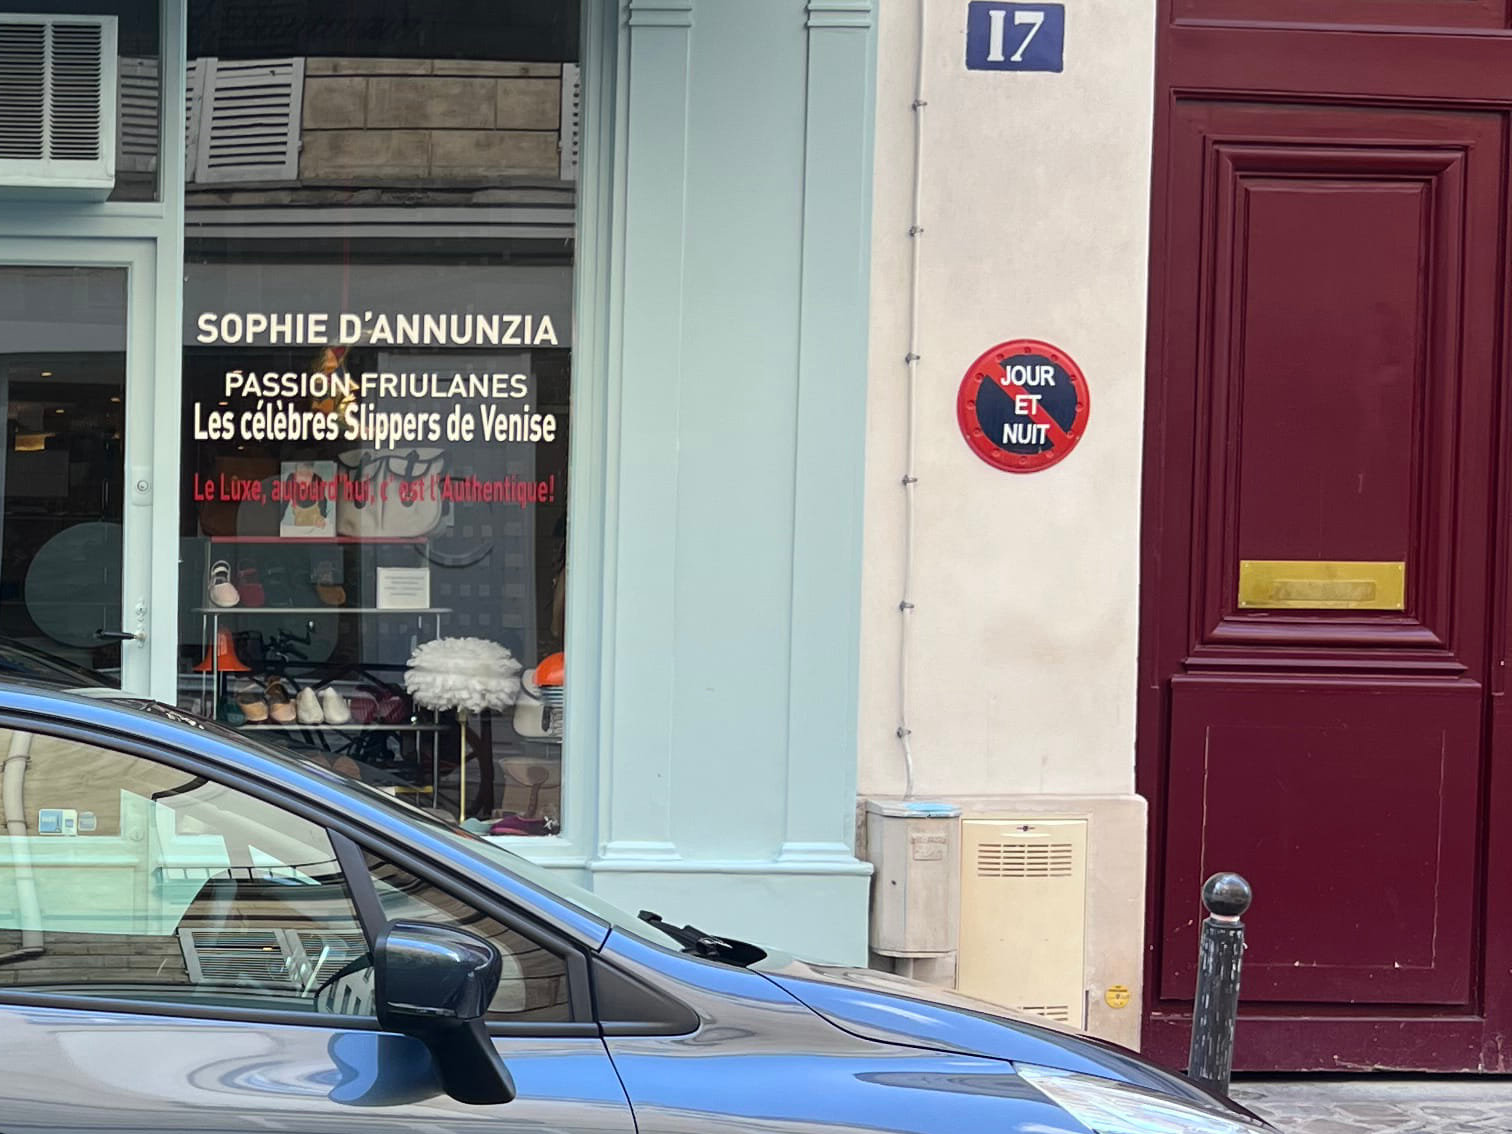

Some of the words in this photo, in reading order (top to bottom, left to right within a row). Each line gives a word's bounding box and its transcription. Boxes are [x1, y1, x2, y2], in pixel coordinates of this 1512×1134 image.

[986, 9, 1045, 62] 17
[196, 313, 329, 345] SOPHIE
[339, 311, 559, 345] D'ANNUNZIA
[224, 372, 351, 398] PASSION
[360, 373, 528, 398] FRIULANES
[1000, 364, 1056, 387] JOUR
[1014, 394, 1042, 416] ET
[193, 402, 236, 441] Les
[240, 399, 339, 441] célèbres
[343, 402, 441, 450] Slippers
[446, 404, 475, 441] de
[480, 404, 557, 442] Venise
[1002, 423, 1050, 445] NUIT
[193, 474, 216, 501] Le
